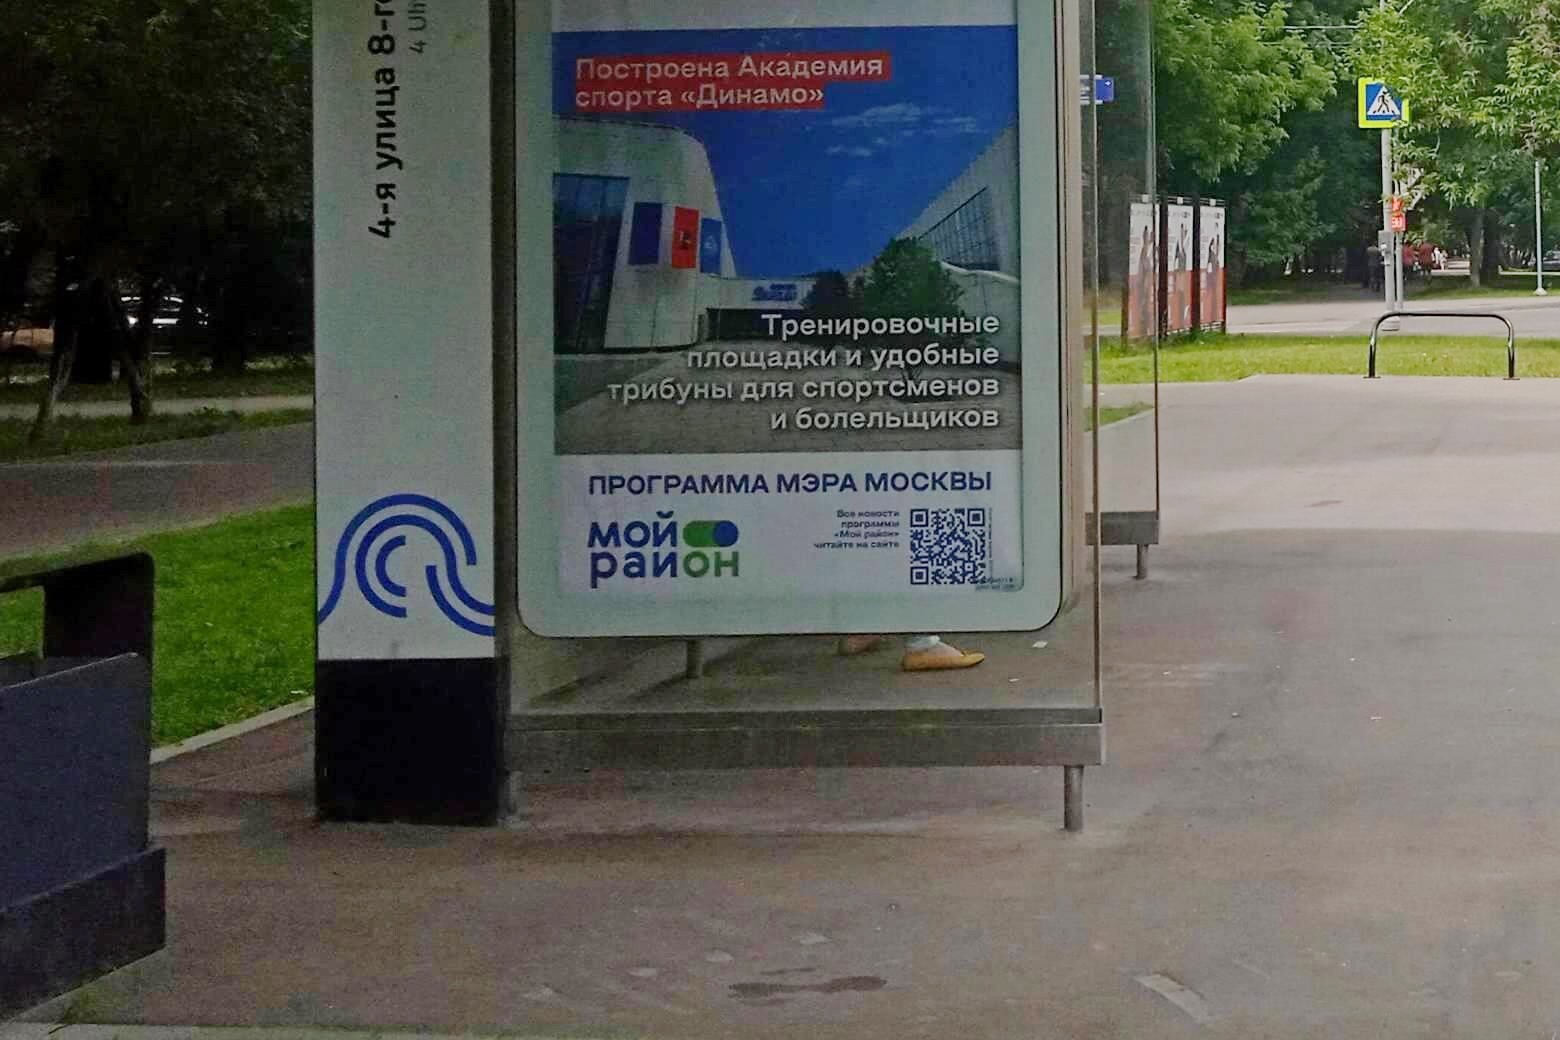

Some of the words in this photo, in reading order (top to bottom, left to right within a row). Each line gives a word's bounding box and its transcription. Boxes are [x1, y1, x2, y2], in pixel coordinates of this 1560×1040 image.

[408, 40, 425, 54] 4
[576, 57, 730, 85] Построена
[738, 55, 884, 79] Академия
[576, 86, 672, 110] спорта
[680, 84, 825, 109] «Динамо»
[375, 67, 403, 169] улица
[367, 181, 396, 239] 4-я
[761, 313, 1000, 341] Тренировочные
[687, 348, 837, 372] площадки
[846, 349, 862, 367] и
[870, 344, 1000, 372] удобные
[608, 378, 734, 406] трибуны
[740, 381, 795, 402] для
[802, 377, 1000, 403] спортсменов
[771, 413, 787, 429] и
[796, 407, 999, 432] болельщиков
[588, 474, 769, 496] ПРОГРАММА
[776, 473, 857, 495] МЭРА
[865, 471, 992, 492] МОСКВЫ
[836, 509, 856, 519] Все
[858, 510, 900, 519] новости
[841, 521, 900, 530] программы
[588, 510, 677, 548] мой
[813, 540, 854, 549] читайте
[870, 540, 900, 549] сайте
